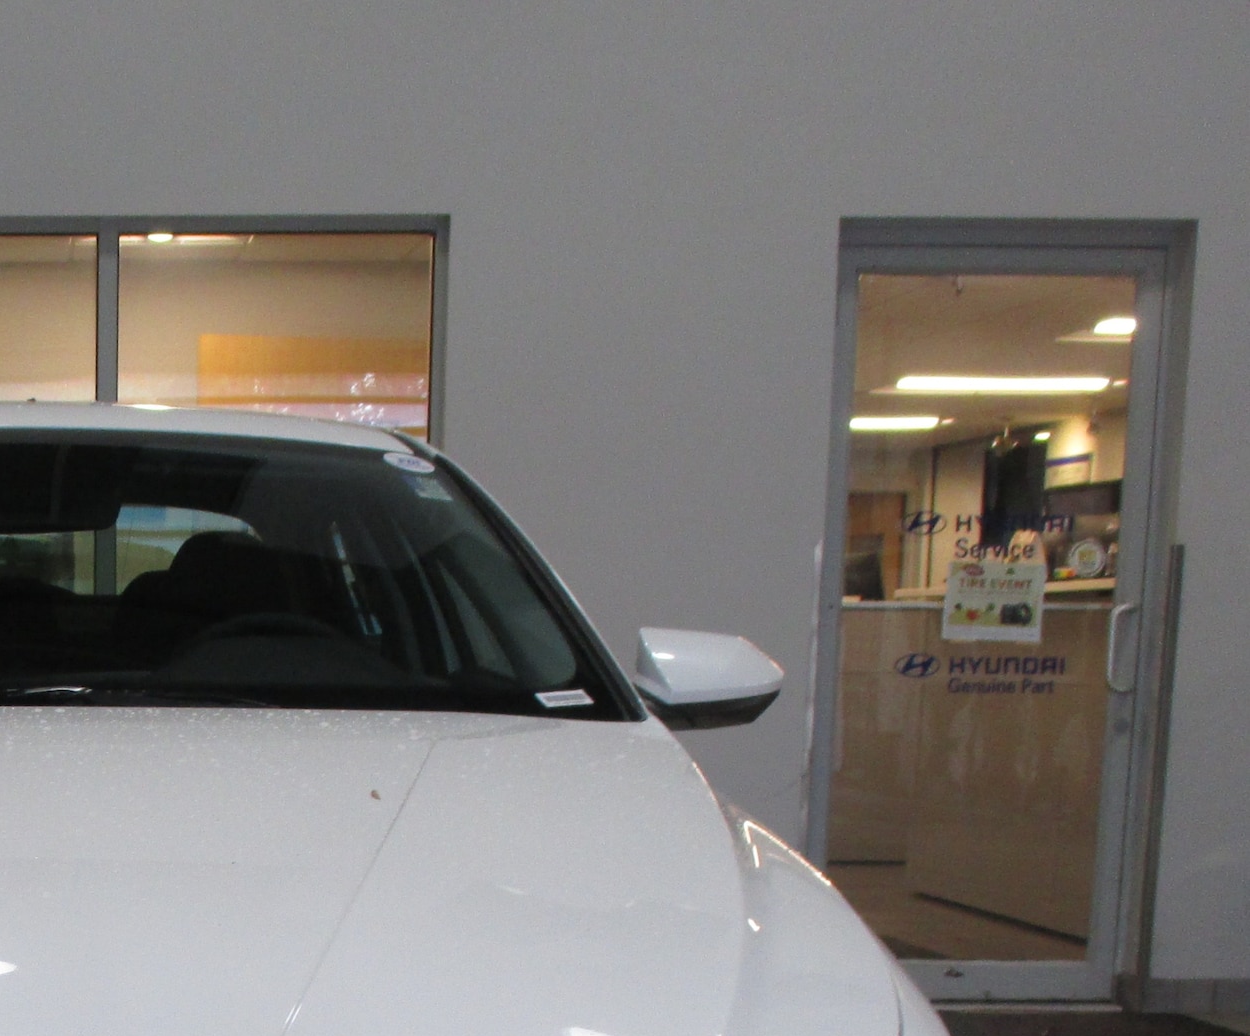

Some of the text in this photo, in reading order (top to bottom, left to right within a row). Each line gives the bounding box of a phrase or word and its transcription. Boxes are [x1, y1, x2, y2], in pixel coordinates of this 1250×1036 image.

[954, 537, 1035, 559] Service
[990, 578, 1033, 589] EVENT
[949, 656, 1066, 675] HYUNDAI
[948, 677, 1055, 694] Genuine Part
